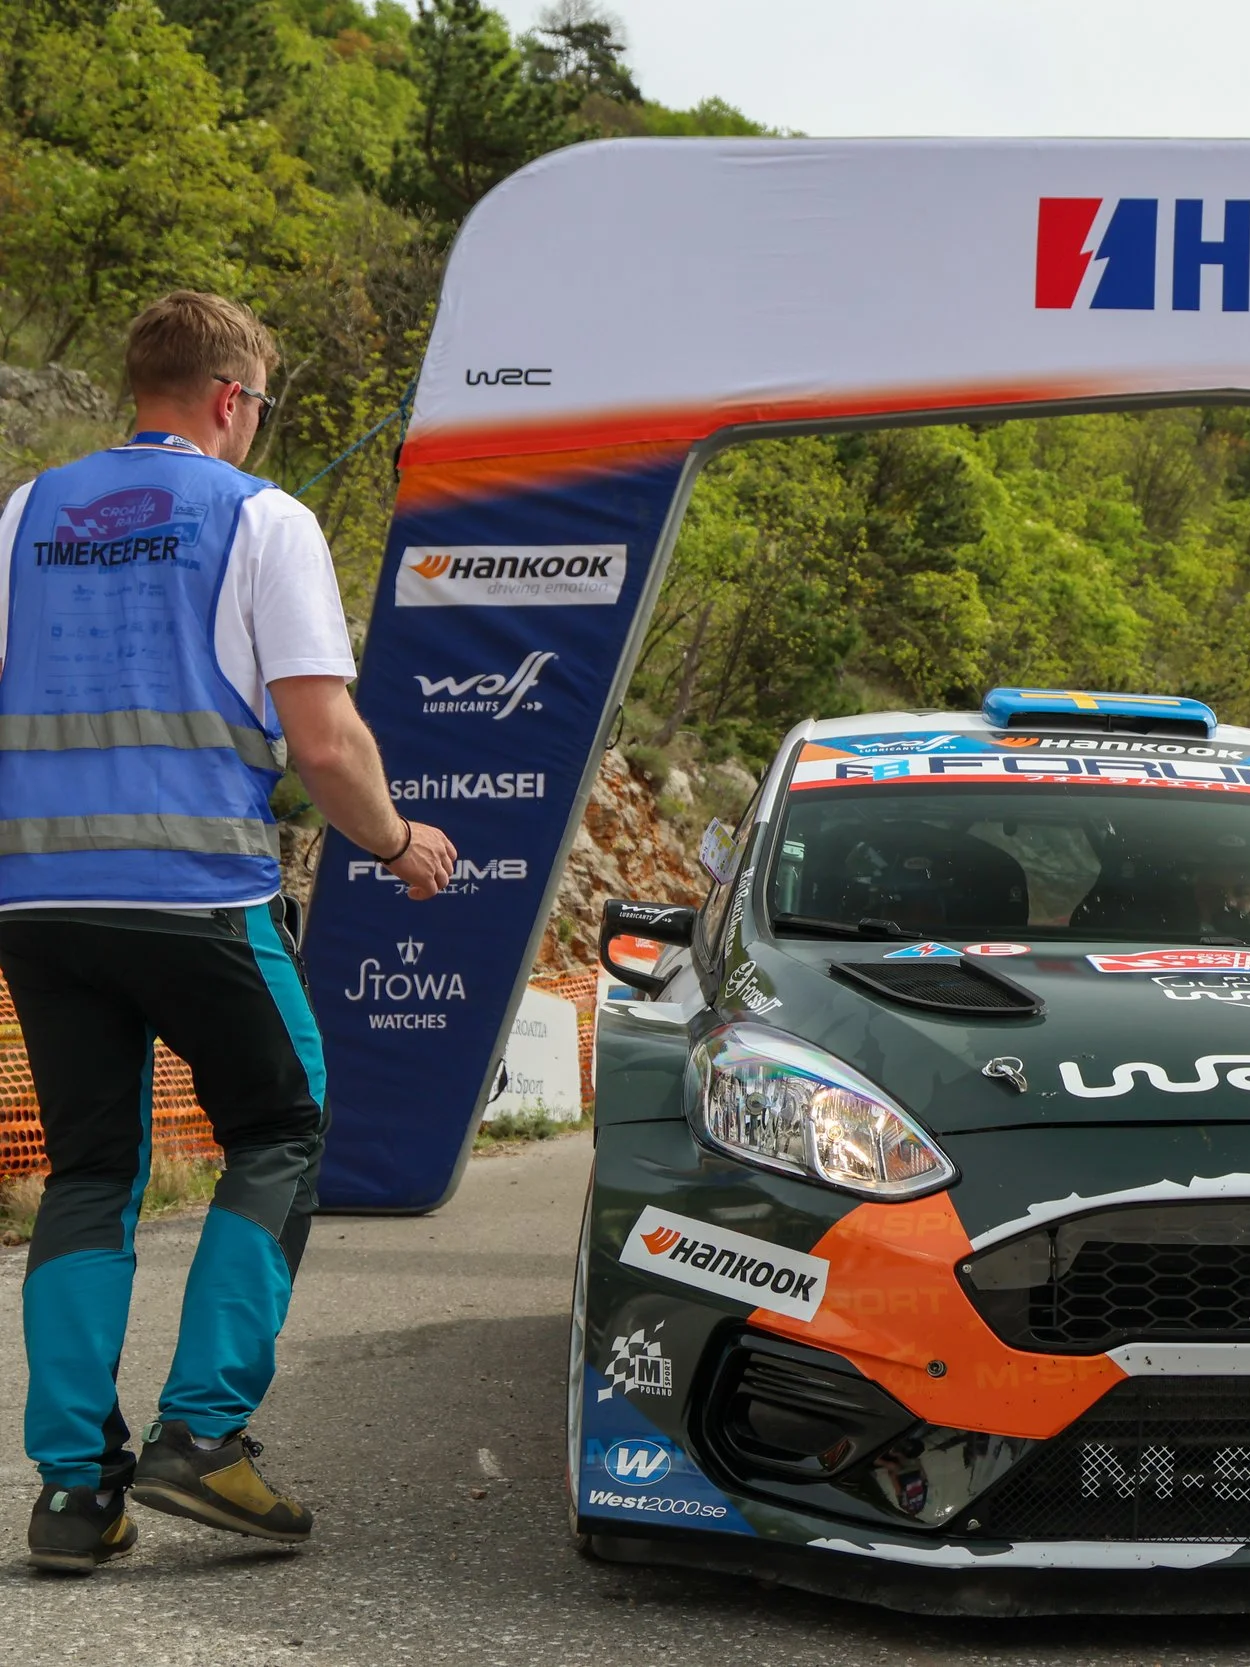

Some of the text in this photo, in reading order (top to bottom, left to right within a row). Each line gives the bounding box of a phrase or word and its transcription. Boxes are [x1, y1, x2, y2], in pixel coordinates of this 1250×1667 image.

[466, 368, 552, 386] WRC
[33, 536, 180, 567] TIMEKEEPER
[487, 580, 609, 597] driving emotion
[423, 701, 500, 714] LUBRICANTS
[859, 744, 921, 754] LUBRICANTS
[390, 773, 546, 800] sahiKASEI
[619, 911, 654, 921] LUBRICANTS
[981, 945, 1014, 954] E
[345, 959, 467, 1001] STOWA
[740, 975, 768, 1010] Forss
[369, 1014, 447, 1029] WATCHES
[638, 1358, 662, 1386] M
[663, 1359, 672, 1388] SPORT
[640, 1384, 673, 1397] POLAND
[616, 1447, 668, 1479] W
[588, 1489, 728, 1519] West2000.se
